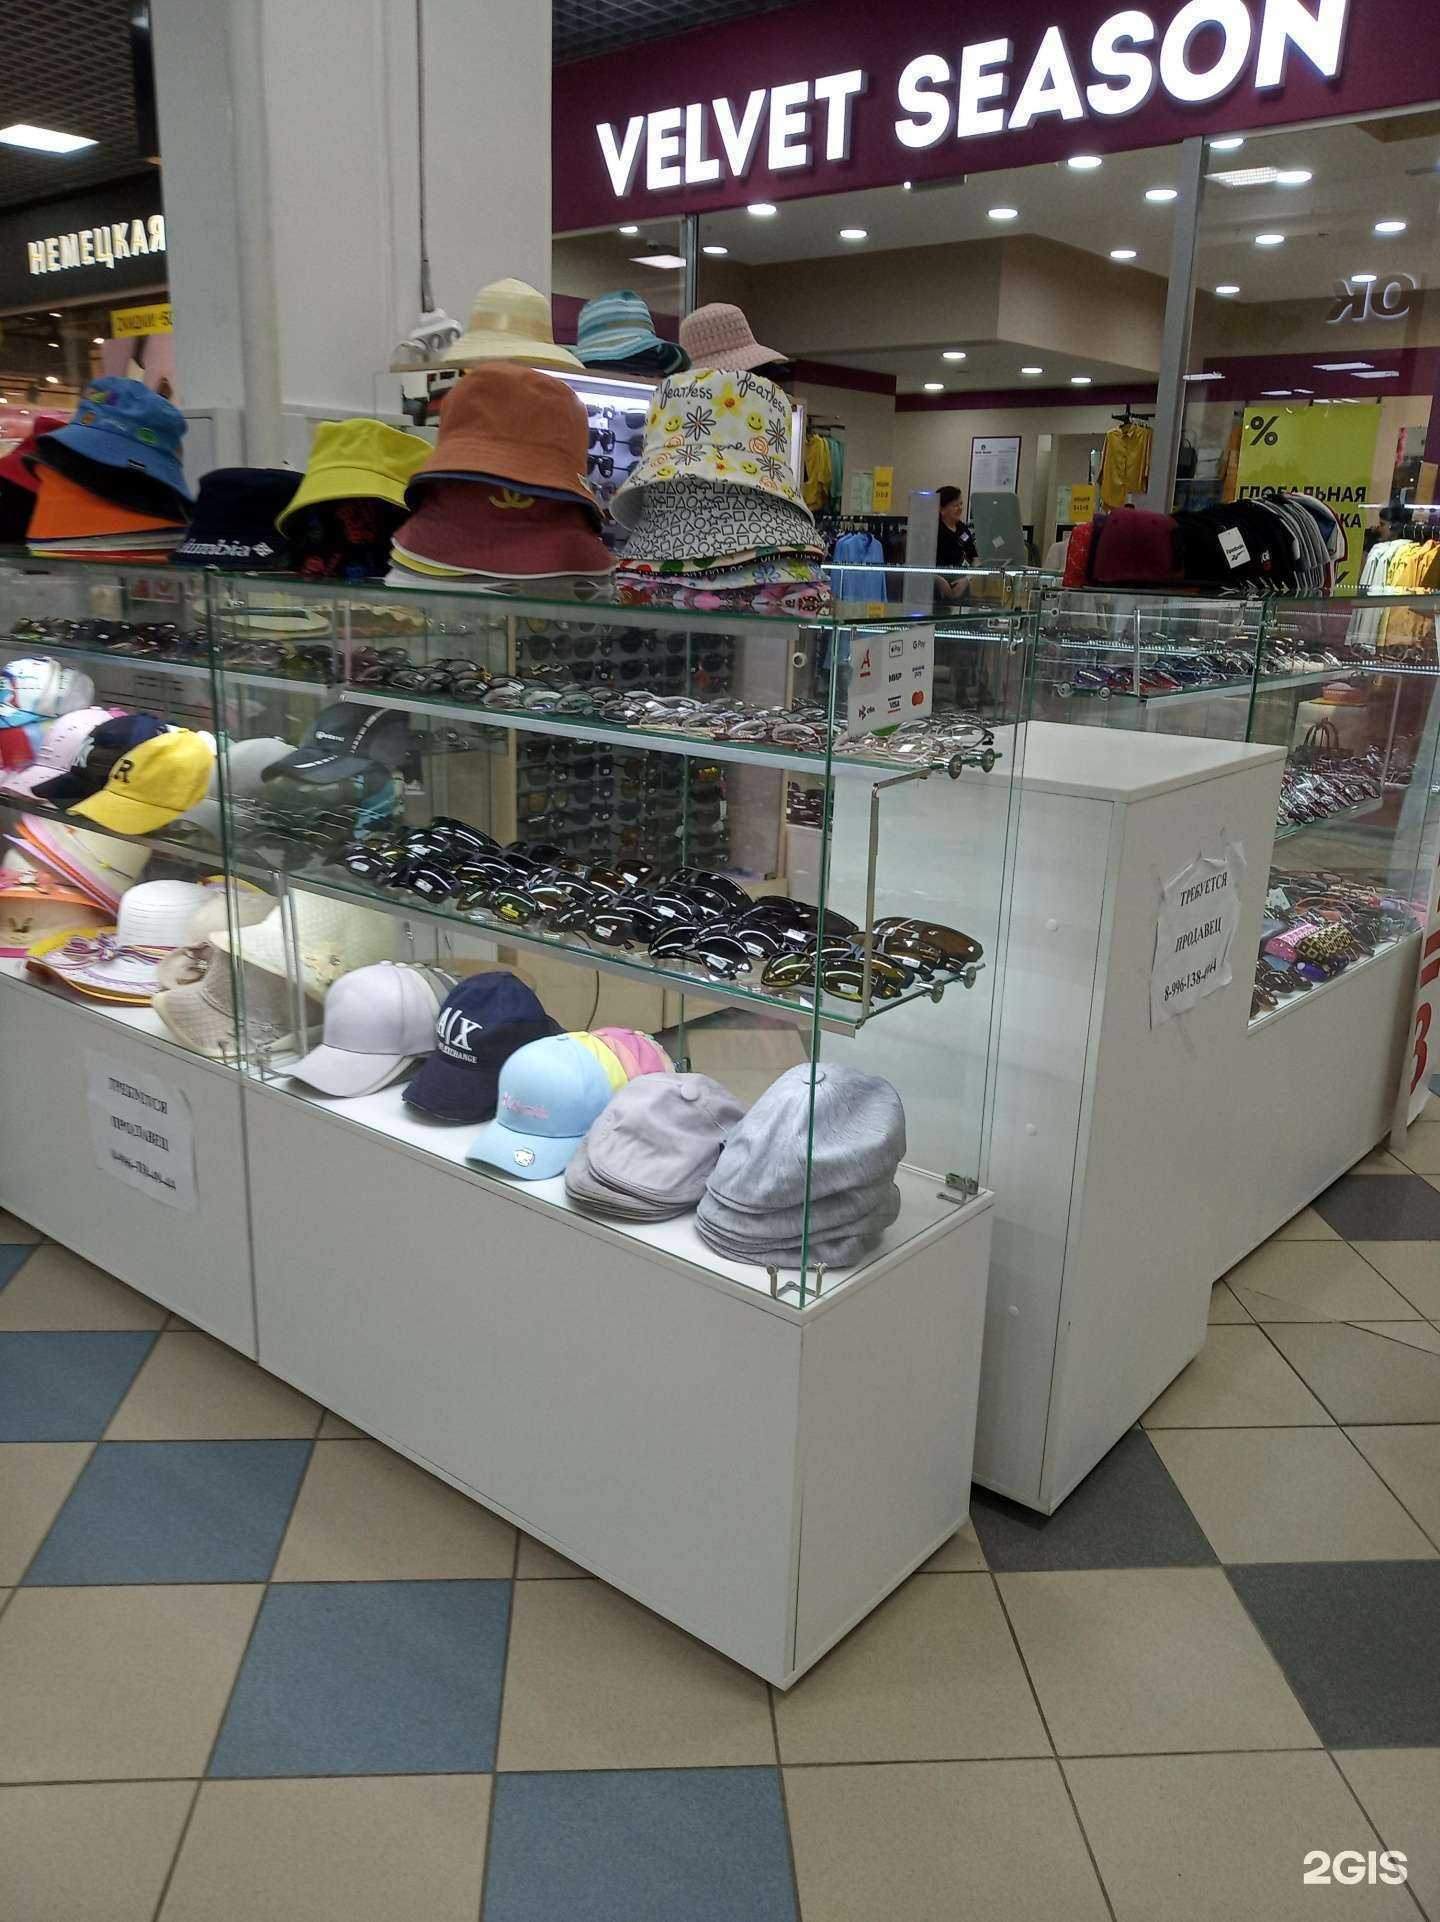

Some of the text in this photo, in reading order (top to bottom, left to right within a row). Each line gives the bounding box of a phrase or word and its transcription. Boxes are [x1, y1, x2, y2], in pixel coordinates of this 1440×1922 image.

[596, 0, 1350, 198] VELVET SEASON
[27, 214, 166, 275] НЕМЕЦКАЯ
[660, 379, 713, 410] fearless
[1250, 415, 1280, 446] %
[1180, 871, 1228, 907] ТРЕБУЕТСЯ
[1174, 917, 1222, 953] ПРОДАВЕЦ
